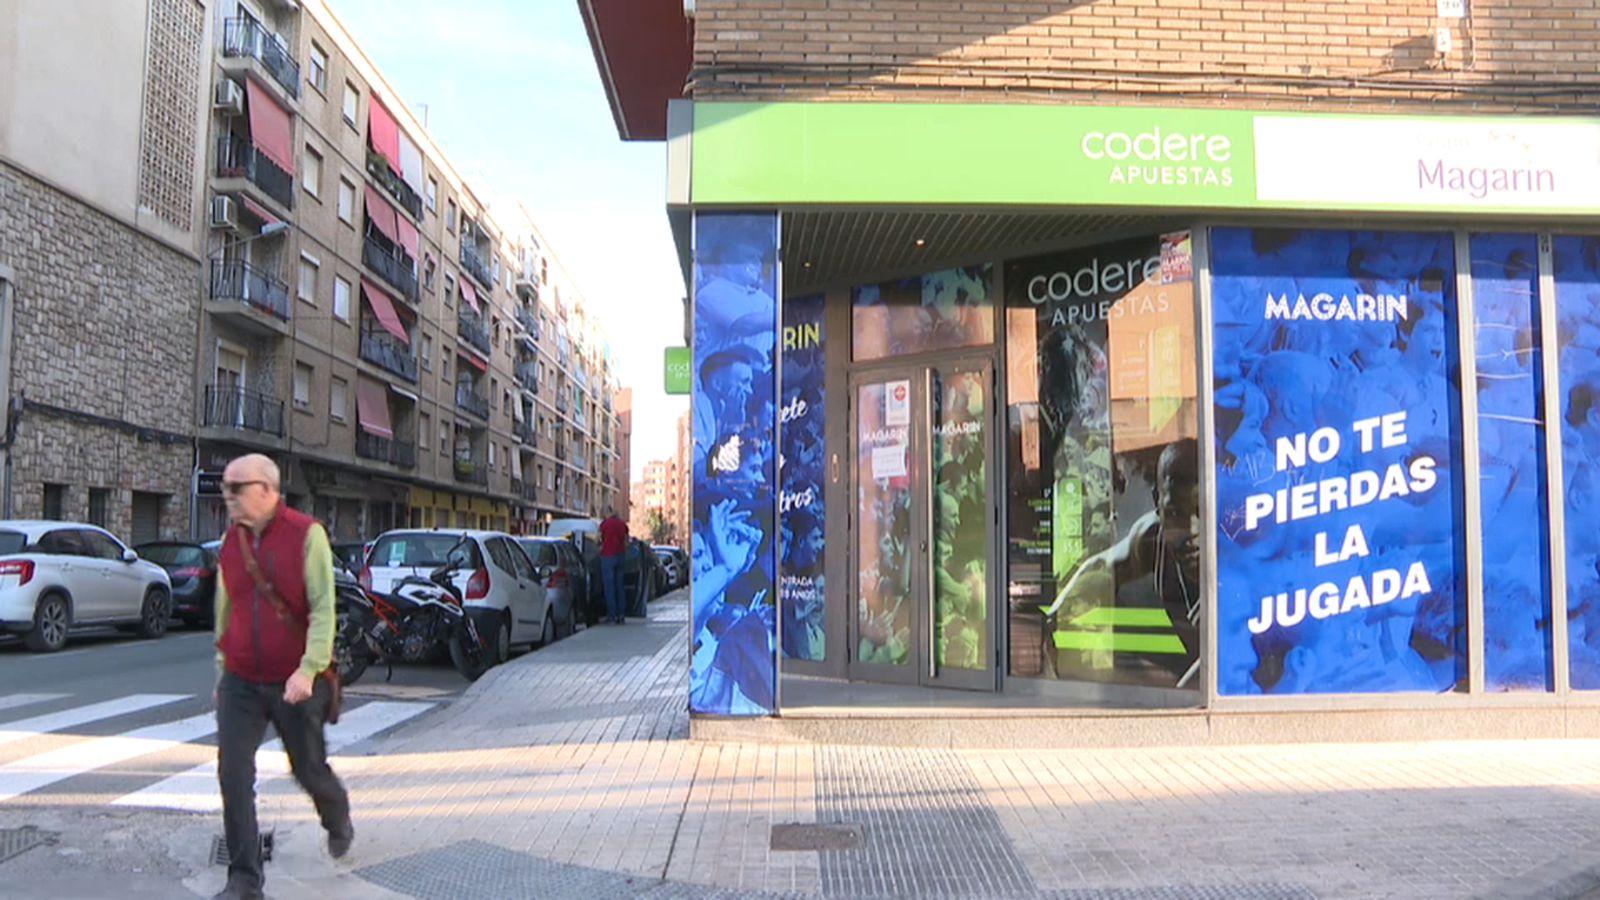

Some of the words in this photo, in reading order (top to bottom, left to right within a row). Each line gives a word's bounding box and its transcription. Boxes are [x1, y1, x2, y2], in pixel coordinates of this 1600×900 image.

[1081, 126, 1231, 162] codere
[1109, 165, 1233, 187] APUESTAS
[1417, 157, 1555, 199] Magarin
[1028, 258, 1162, 304] codere
[1051, 291, 1170, 327] APUESTAS
[1264, 292, 1408, 322] MAGARIN
[1276, 426, 1341, 472] NO
[1353, 410, 1408, 453] TE
[1245, 456, 1437, 531] PIERDAS
[1315, 523, 1370, 568] LA
[1248, 561, 1432, 635] JUGADA
